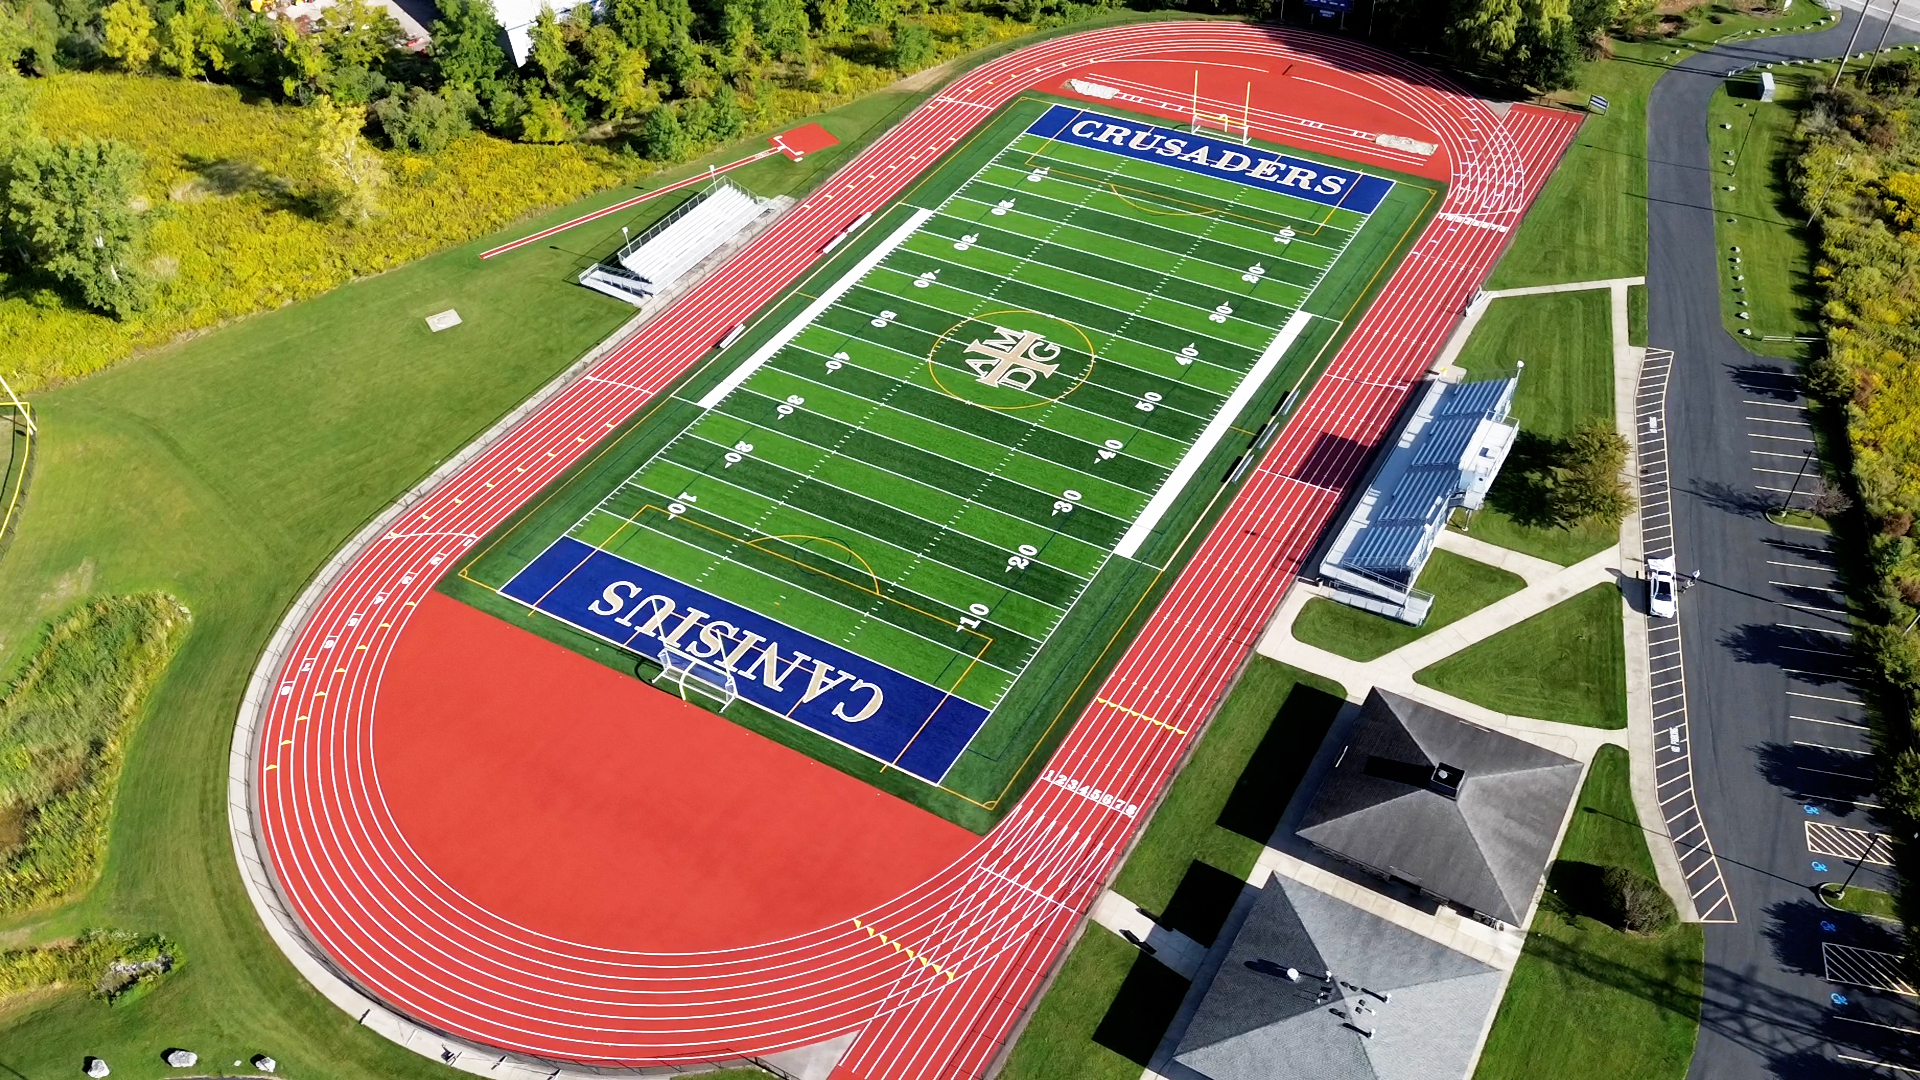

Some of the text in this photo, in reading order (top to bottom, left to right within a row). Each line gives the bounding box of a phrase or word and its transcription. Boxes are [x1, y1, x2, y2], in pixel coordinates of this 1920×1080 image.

[1071, 120, 1346, 195] CRUSADERS
[1273, 229, 1296, 245] 10
[1241, 266, 1265, 283] 20
[871, 310, 898, 328] 50
[1208, 305, 1233, 323] 30
[825, 351, 850, 370] 40
[1175, 347, 1199, 365] 40
[776, 395, 804, 415] 30
[1134, 391, 1162, 412] 50
[724, 440, 754, 463] 20
[1097, 439, 1123, 460] 40
[667, 491, 697, 514] 10
[1053, 489, 1082, 513] 30
[1008, 544, 1038, 570] 20
[959, 603, 989, 630] 10
[588, 580, 884, 723] CANISIUS
